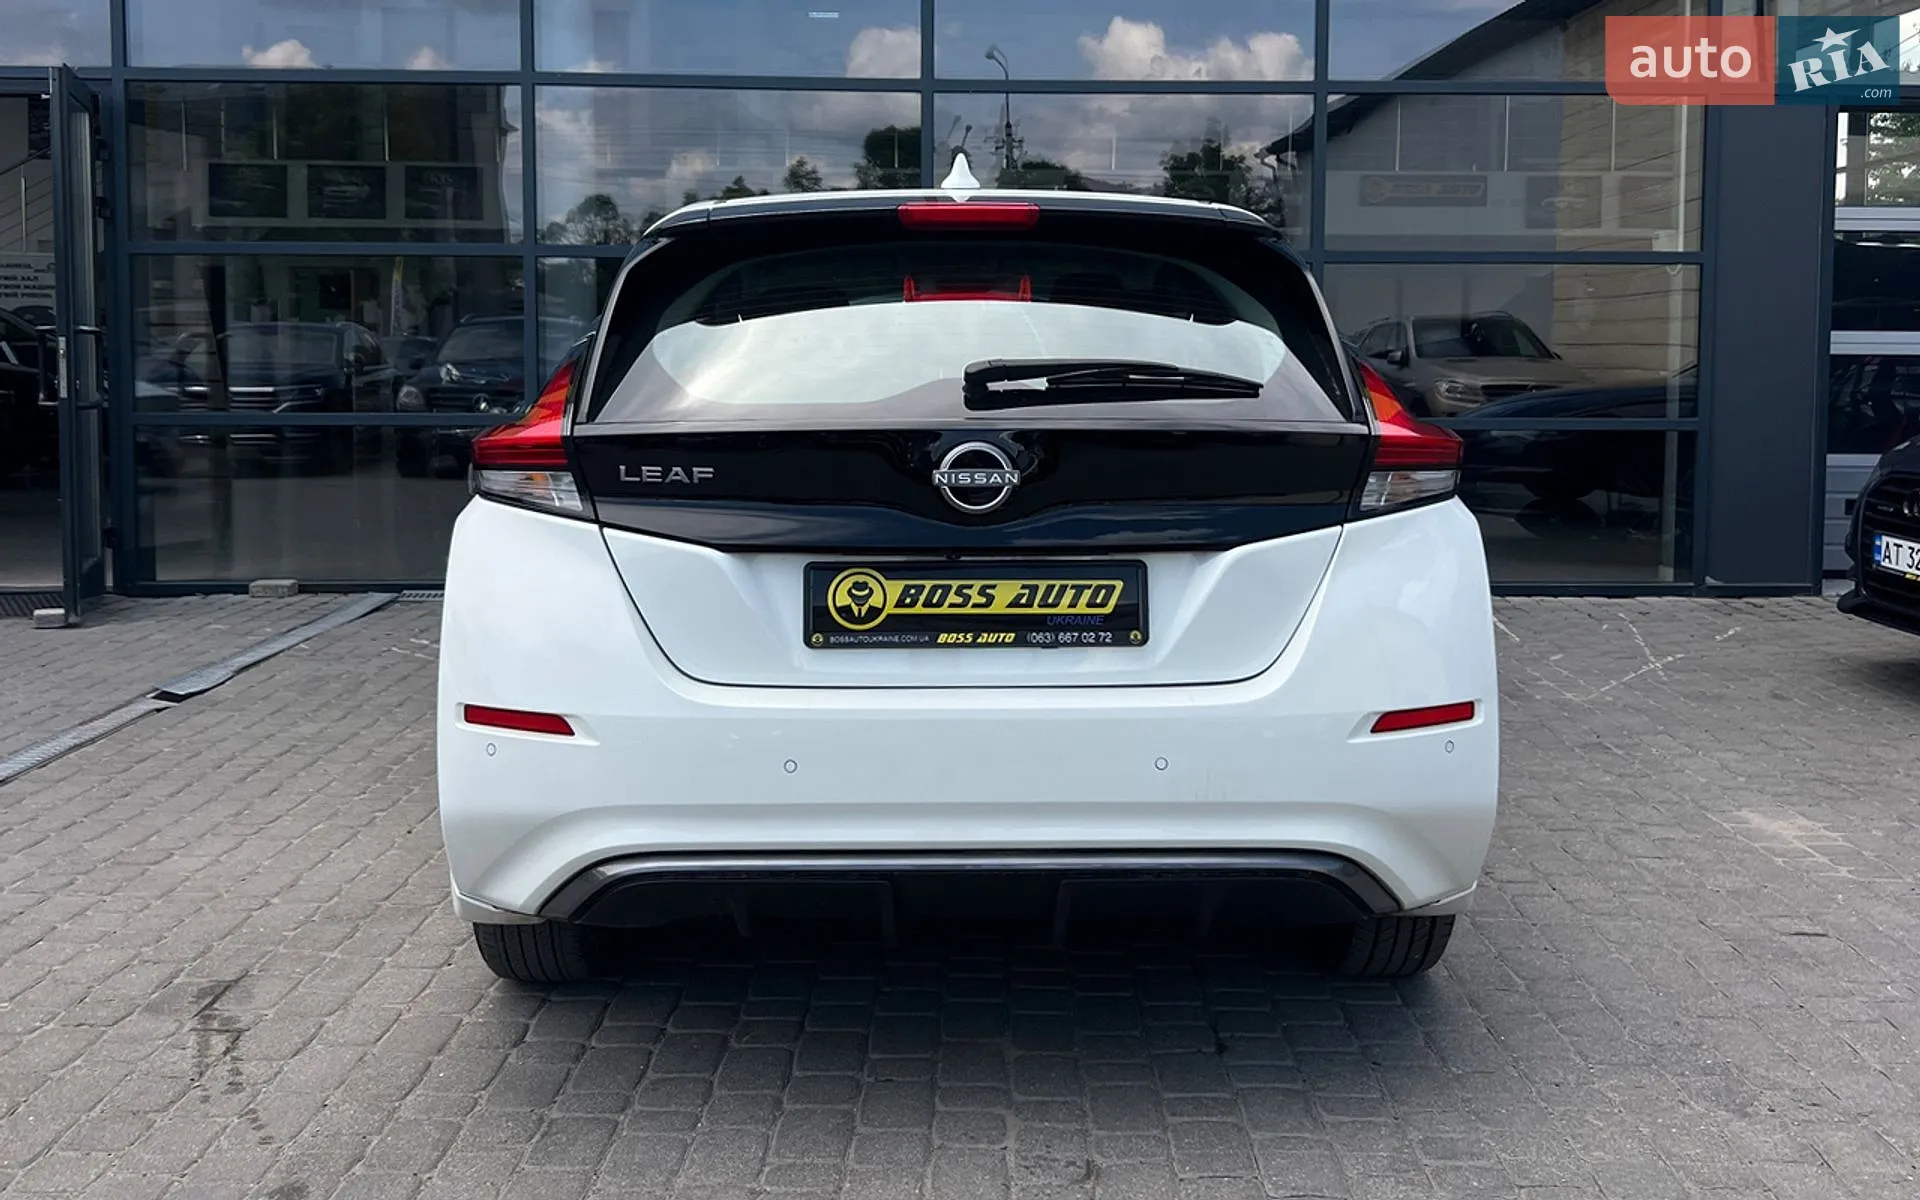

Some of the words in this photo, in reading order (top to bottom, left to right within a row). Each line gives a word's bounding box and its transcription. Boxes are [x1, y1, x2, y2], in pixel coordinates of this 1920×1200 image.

[619, 465, 715, 483] LEAF
[935, 472, 1019, 484] NISSAN
[1882, 541, 1903, 566] AT
[893, 584, 998, 609] BOSS
[1005, 584, 1117, 609] AUTO
[1046, 615, 1105, 625] UKRAINE
[936, 632, 974, 644] BOSS
[976, 632, 1017, 644] AUTO
[1026, 632, 1055, 644] (063)
[1058, 632, 1079, 644] 667
[1081, 632, 1096, 644] 02
[1098, 631, 1113, 643] 72
